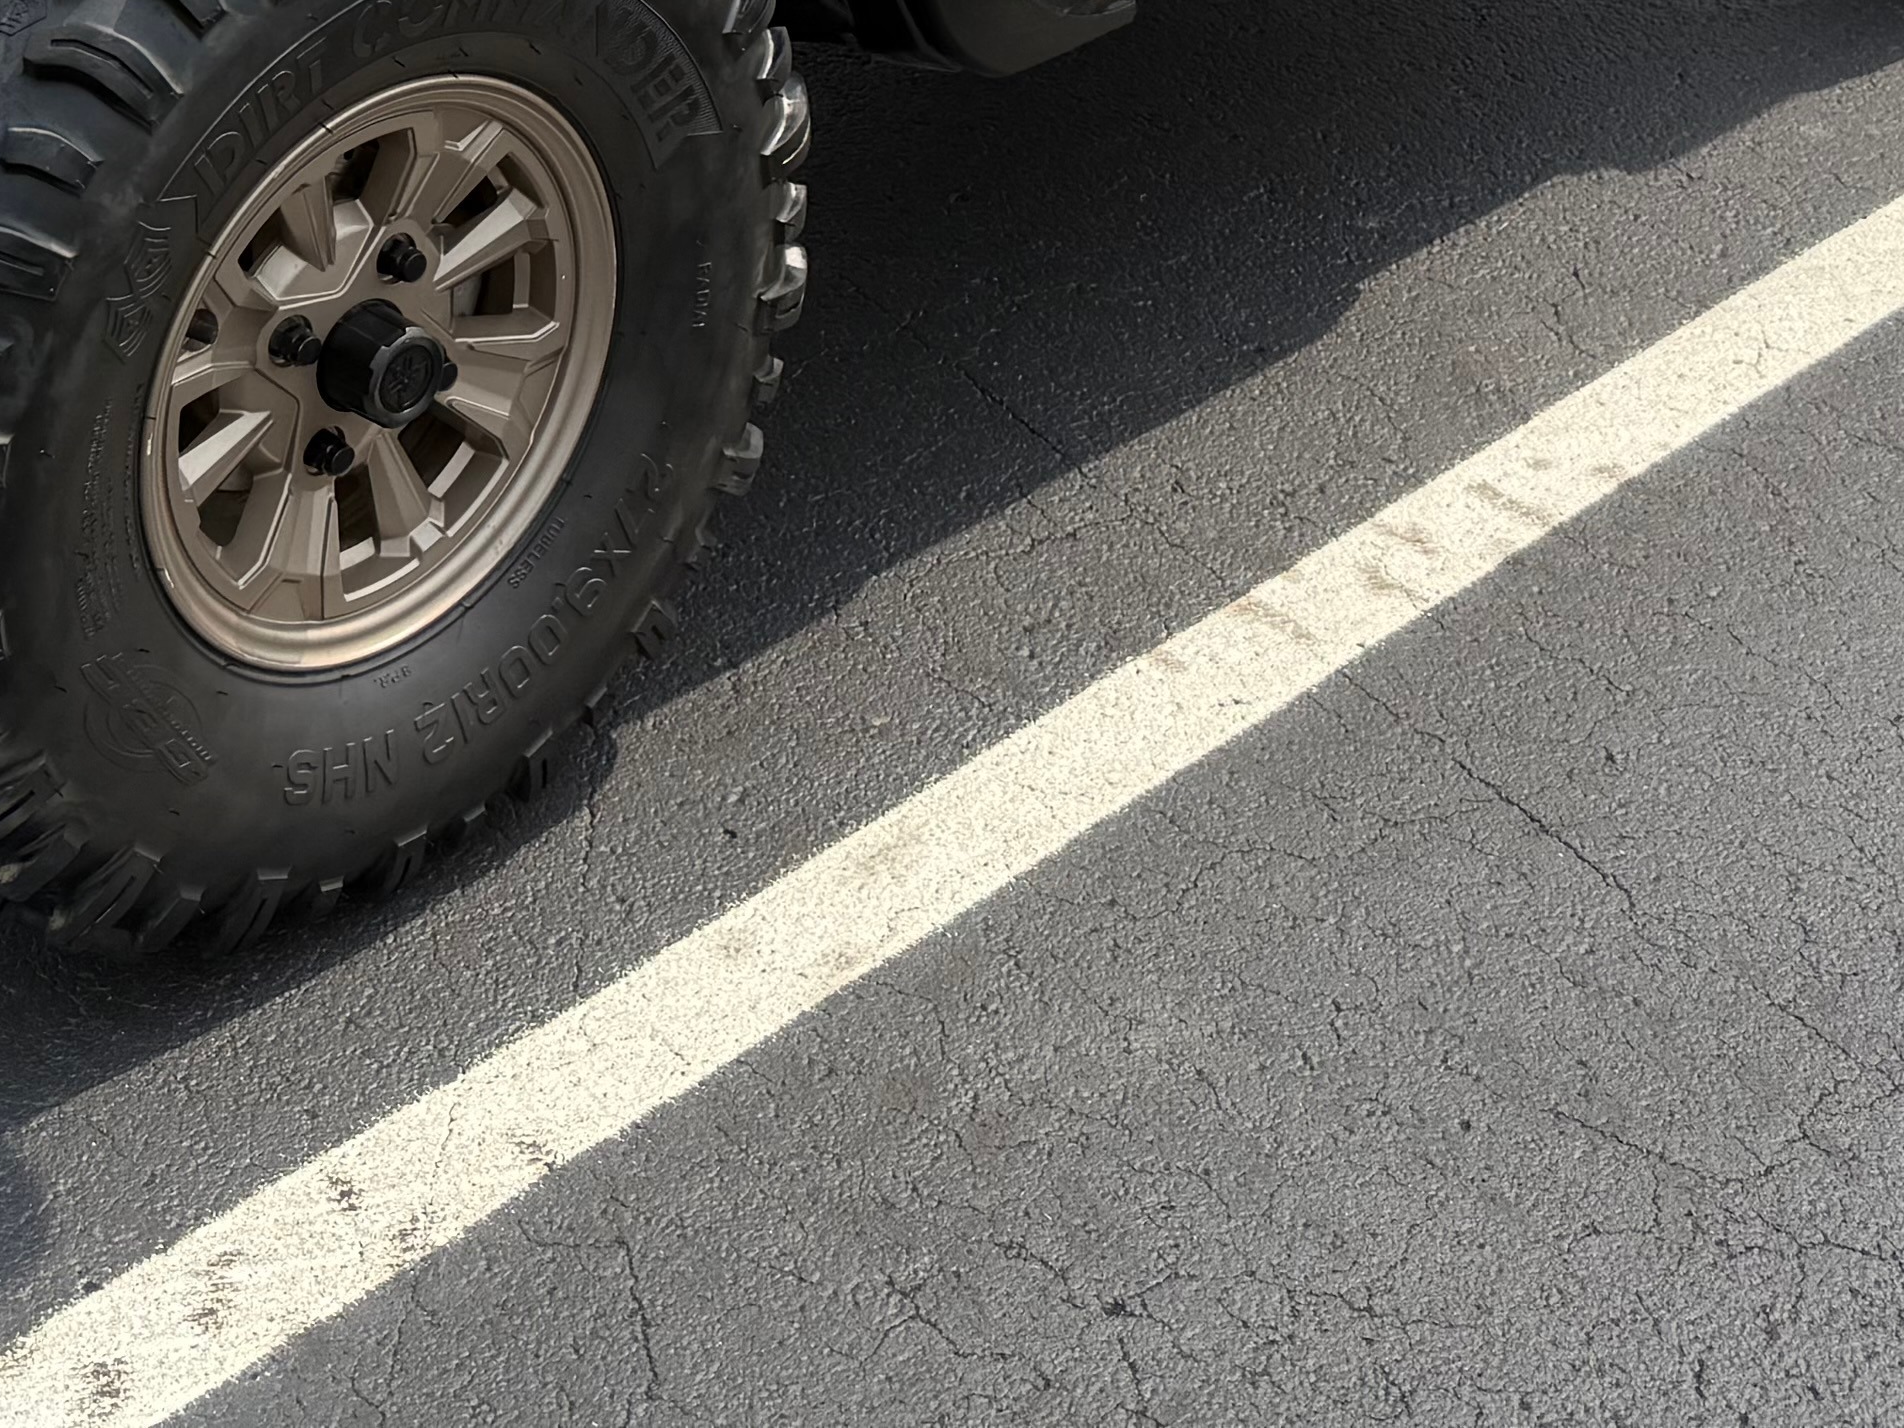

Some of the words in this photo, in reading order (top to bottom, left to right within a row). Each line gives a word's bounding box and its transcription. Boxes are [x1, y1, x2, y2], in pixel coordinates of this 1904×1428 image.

[194, 34, 330, 200] DIRT
[506, 515, 568, 591] TUBELESS
[281, 726, 398, 808] NHS
